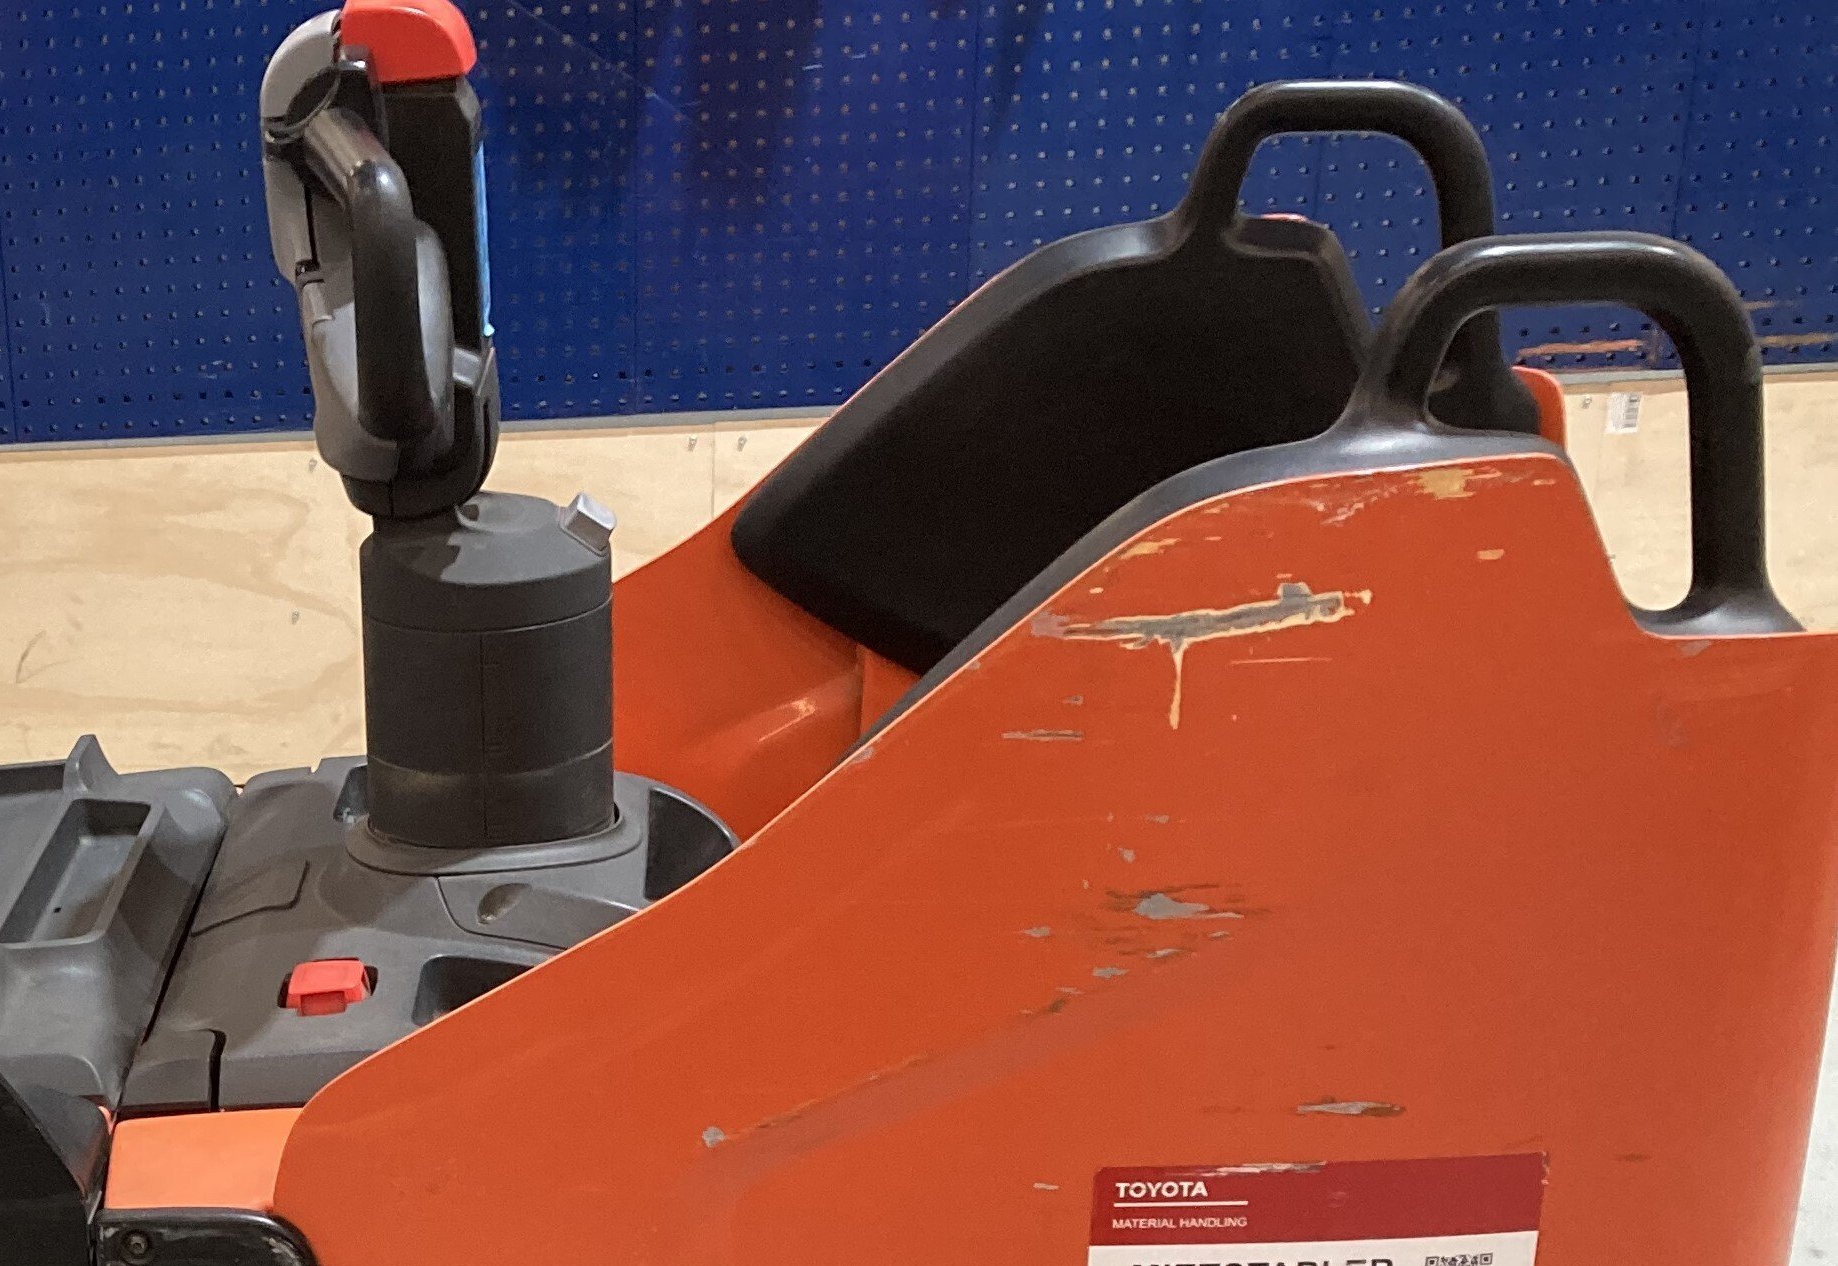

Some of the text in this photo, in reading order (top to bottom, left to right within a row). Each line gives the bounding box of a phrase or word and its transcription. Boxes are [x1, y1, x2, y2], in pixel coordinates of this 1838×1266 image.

[1115, 1181, 1209, 1198] TOYOTA
[1112, 1217, 1248, 1229] MATERIAL HANDLING
